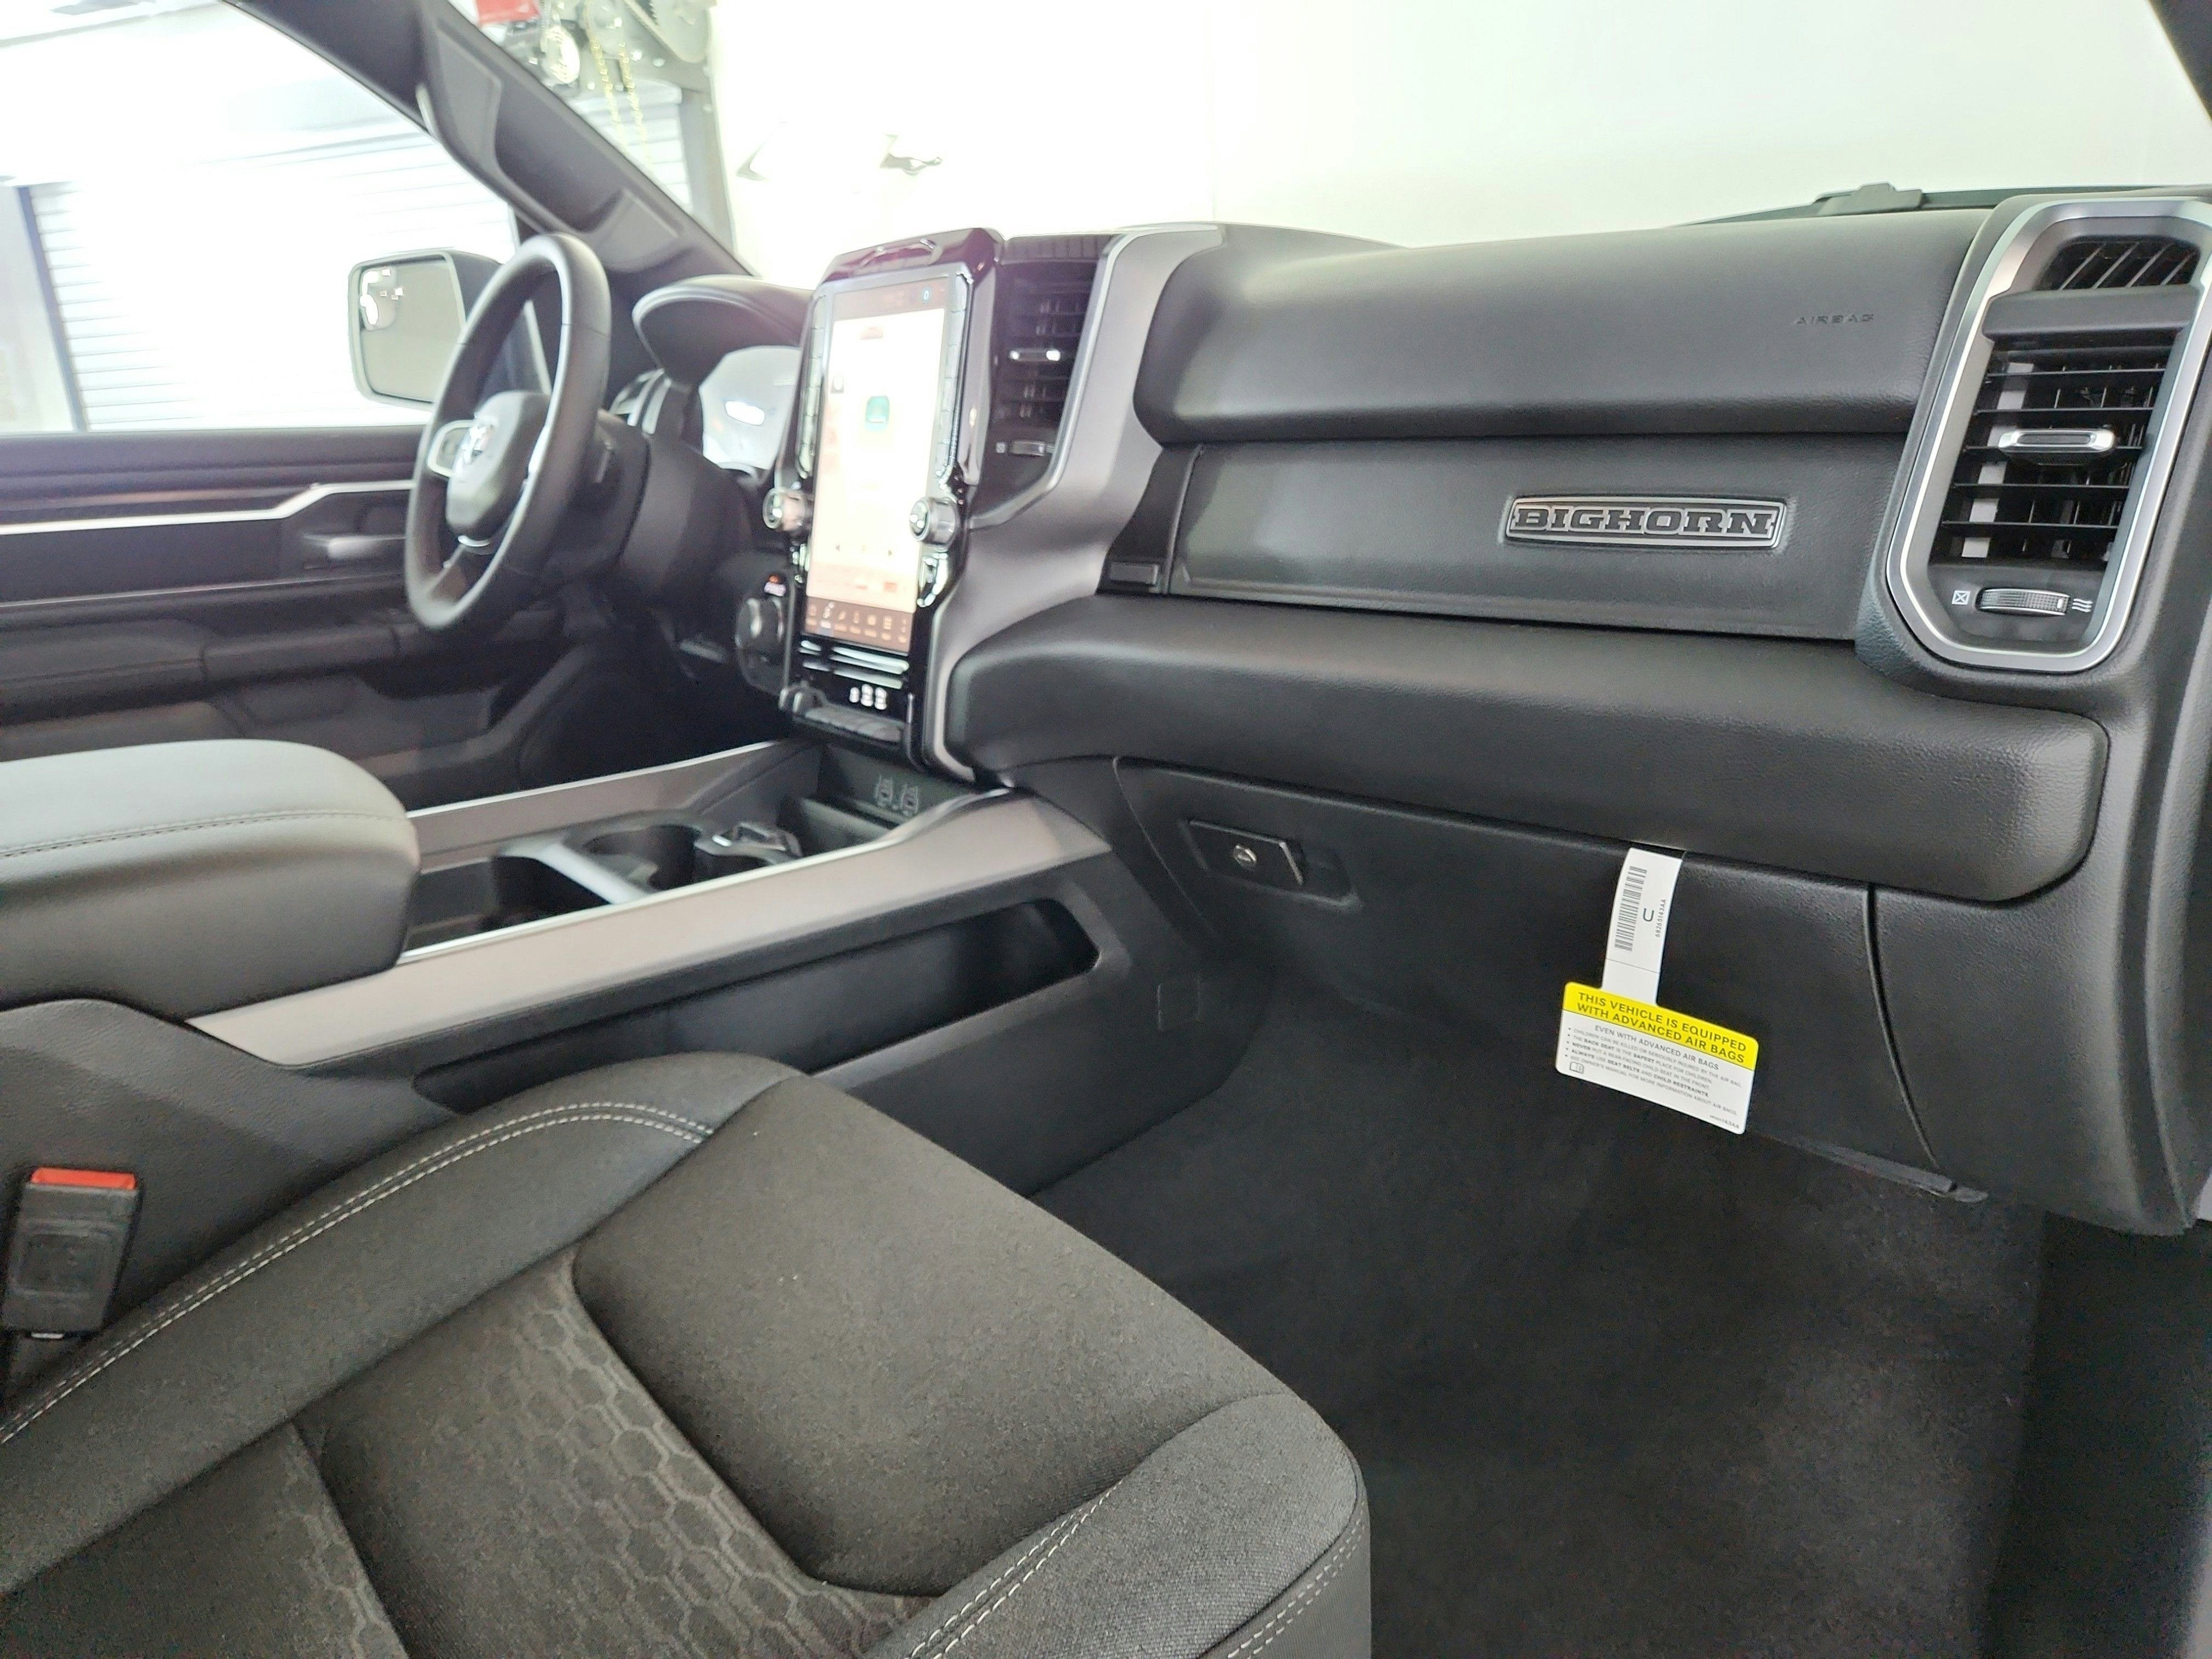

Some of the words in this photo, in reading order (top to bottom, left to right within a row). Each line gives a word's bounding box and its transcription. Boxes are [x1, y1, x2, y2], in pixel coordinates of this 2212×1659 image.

[1791, 313, 1874, 325] AIRBAG
[1511, 506, 1776, 537] BIGHORN
[1643, 907, 1655, 922] U
[1576, 1002, 1609, 1018] WITH
[1612, 1012, 1681, 1041] ADVANCED
[1685, 1035, 1706, 1049] AIR
[1711, 1043, 1744, 1063] BAGS
[1577, 991, 1606, 1007] THIS
[1610, 1000, 1663, 1024] VEHICLE
[1666, 1017, 1678, 1029] IS
[1682, 1023, 1746, 1052] EQUIPPED
[1595, 1025, 1614, 1036] EVEN
[1616, 1031, 1637, 1042] WITH
[1639, 1037, 1681, 1057] ADVANCED
[1683, 1052, 1696, 1062] AIR
[1698, 1057, 1719, 1070] BAGS
